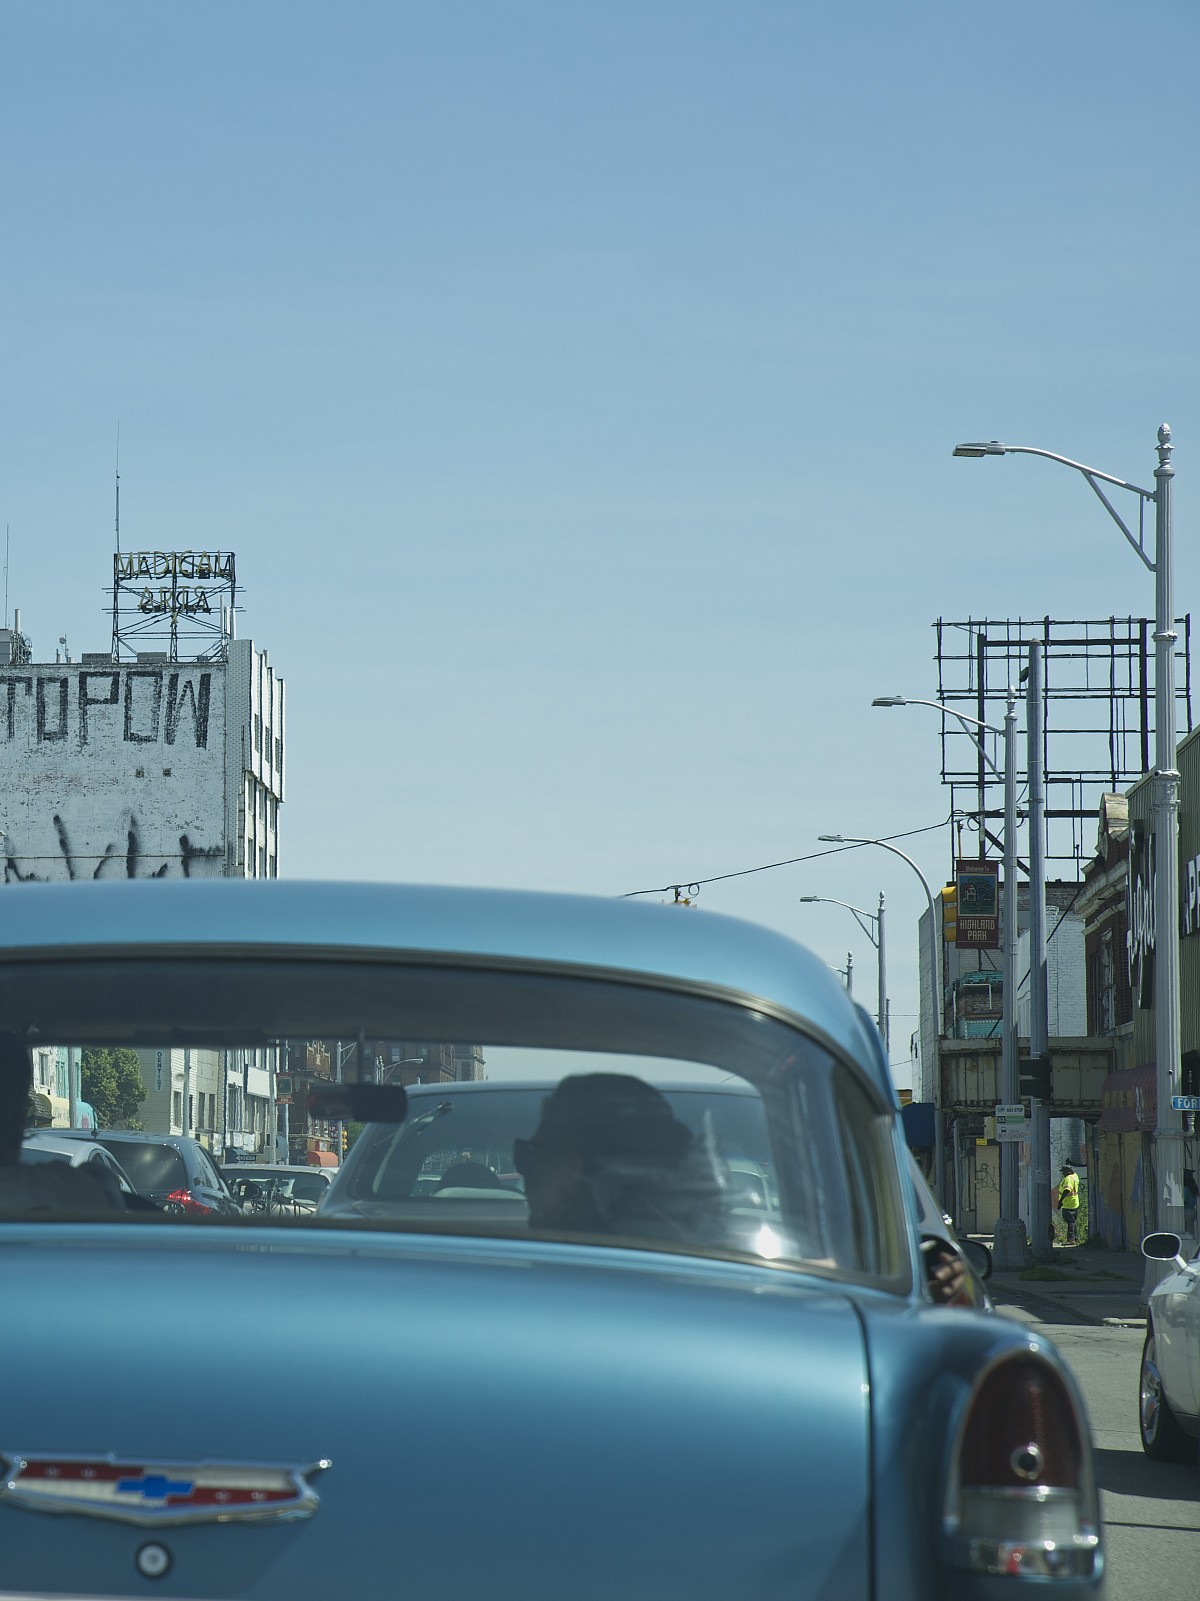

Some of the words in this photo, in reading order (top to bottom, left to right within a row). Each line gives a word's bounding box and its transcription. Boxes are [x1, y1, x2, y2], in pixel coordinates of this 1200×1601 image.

[960, 919, 995, 930] HIGHLAND
[967, 930, 987, 941] PARK
[1177, 1098, 1200, 1109] FOR
